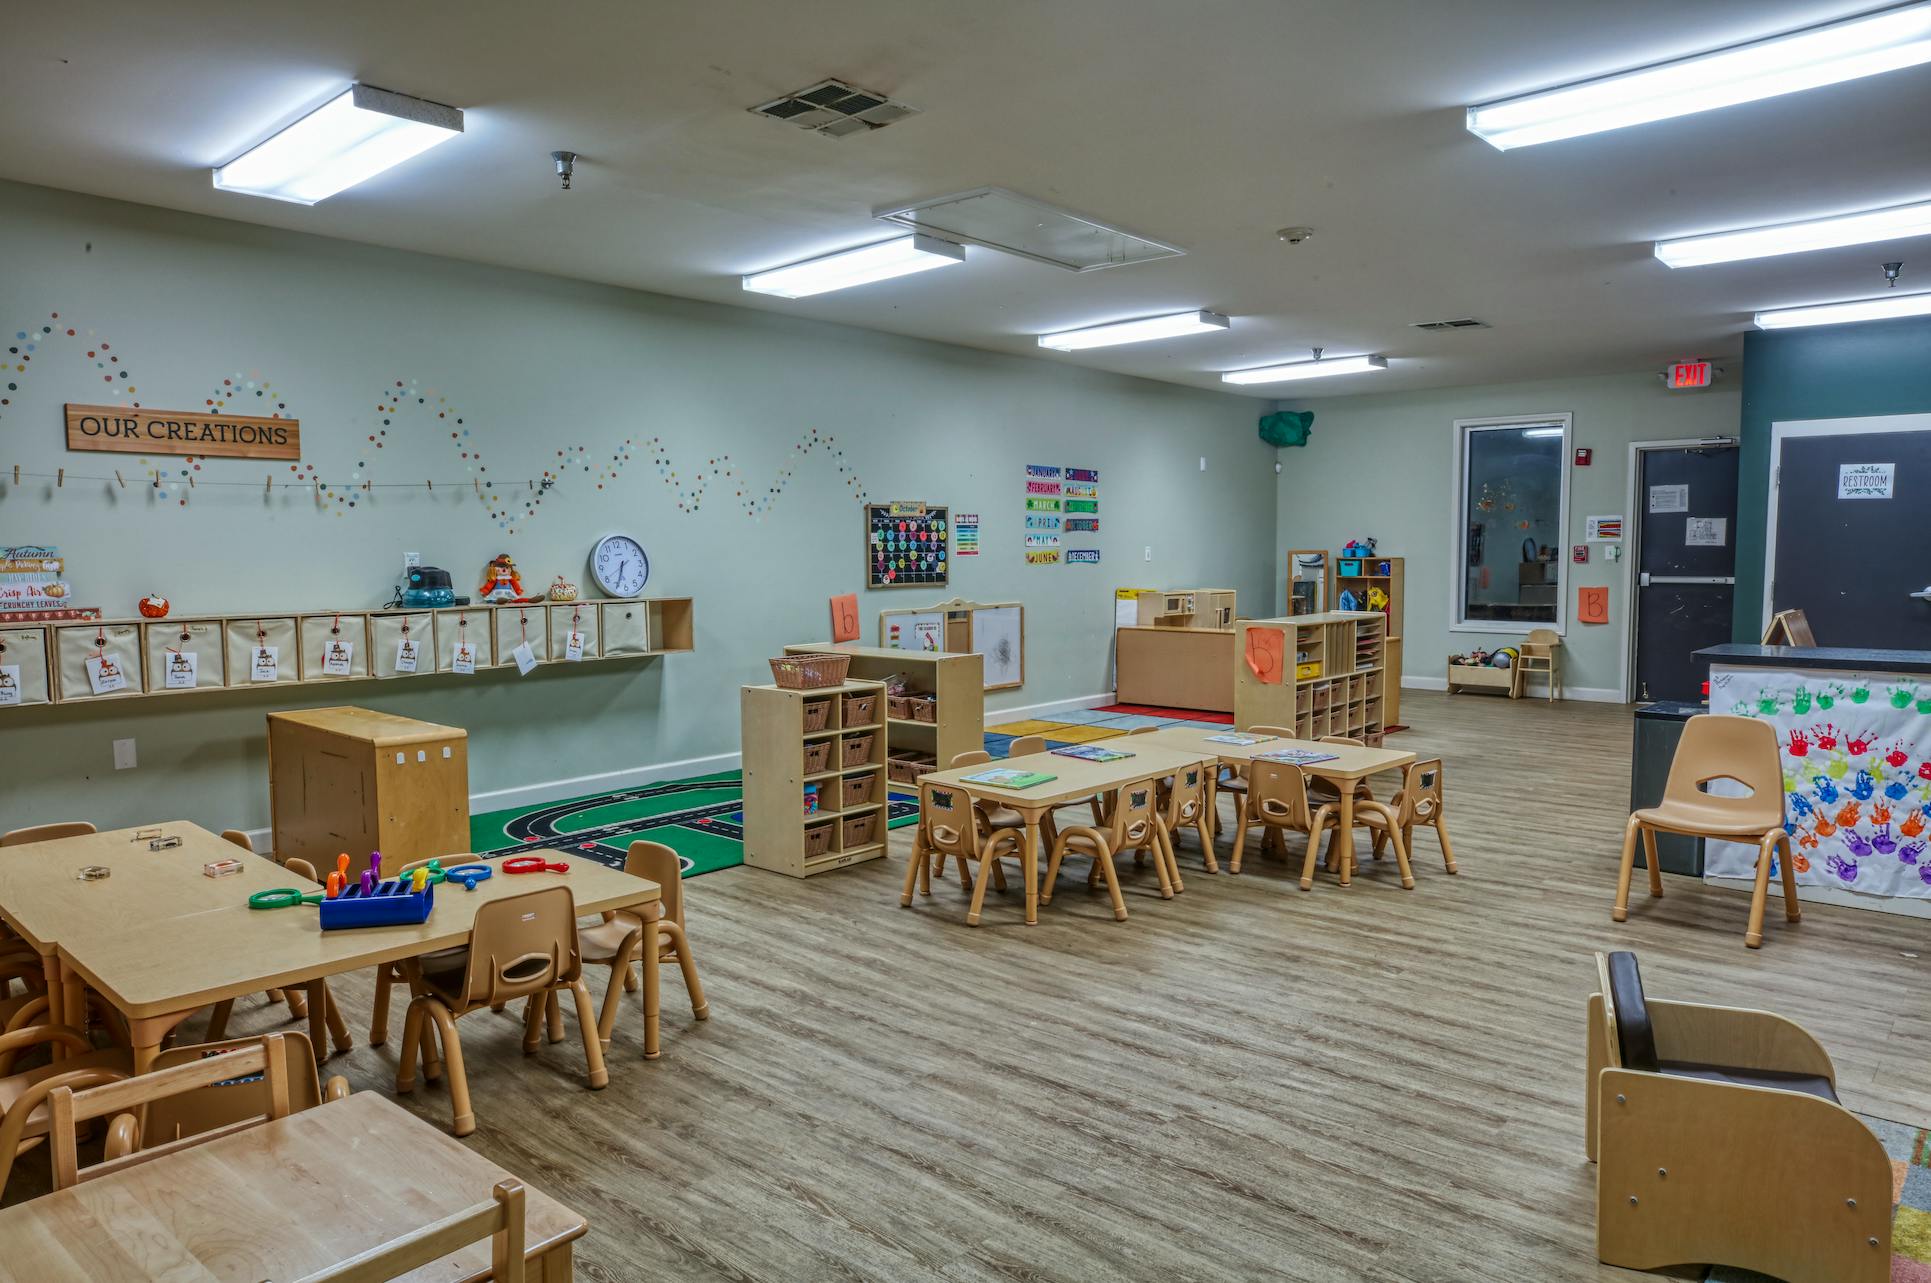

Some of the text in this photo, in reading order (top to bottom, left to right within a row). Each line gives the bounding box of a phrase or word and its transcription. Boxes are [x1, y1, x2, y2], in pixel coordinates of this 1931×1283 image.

[1675, 363, 1707, 386] EXIT
[80, 416, 288, 445] OUR CREATIONS
[1843, 475, 1888, 488] RESTROOM
[1033, 500, 1055, 510] MARCH
[612, 541, 620, 549] 12
[1036, 536, 1049, 545] MAY
[3, 546, 55, 560] Autumn
[600, 554, 609, 562] 10
[1034, 552, 1052, 563] JUNE
[26, 585, 42, 597] Air
[3, 601, 34, 609] CRUNCHY
[1587, 592, 1604, 618] B
[841, 601, 854, 634] b
[1250, 631, 1274, 674] b
